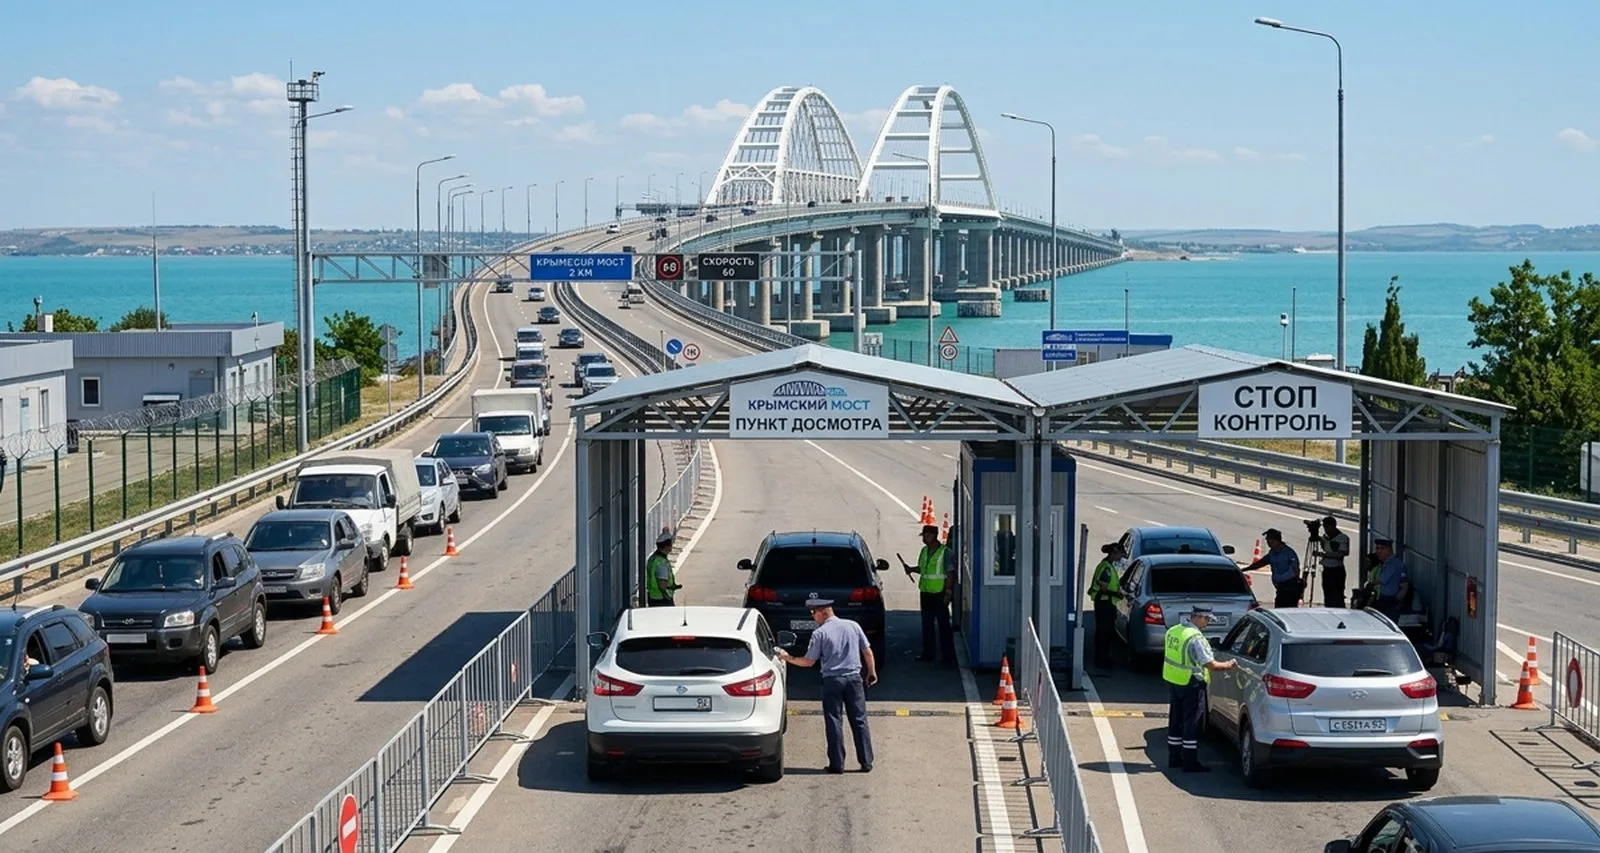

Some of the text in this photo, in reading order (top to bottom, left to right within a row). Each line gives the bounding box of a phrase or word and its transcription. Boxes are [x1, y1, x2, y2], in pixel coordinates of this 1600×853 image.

[597, 258, 625, 267] МОСТ
[569, 268, 576, 277] 2
[722, 268, 735, 277] 60
[1234, 385, 1317, 409] СТОП
[831, 400, 870, 411] МОСТ
[736, 418, 882, 433] ПУНКТ ДОСМОТРА
[1214, 414, 1337, 431] КОНТРОЛЬ
